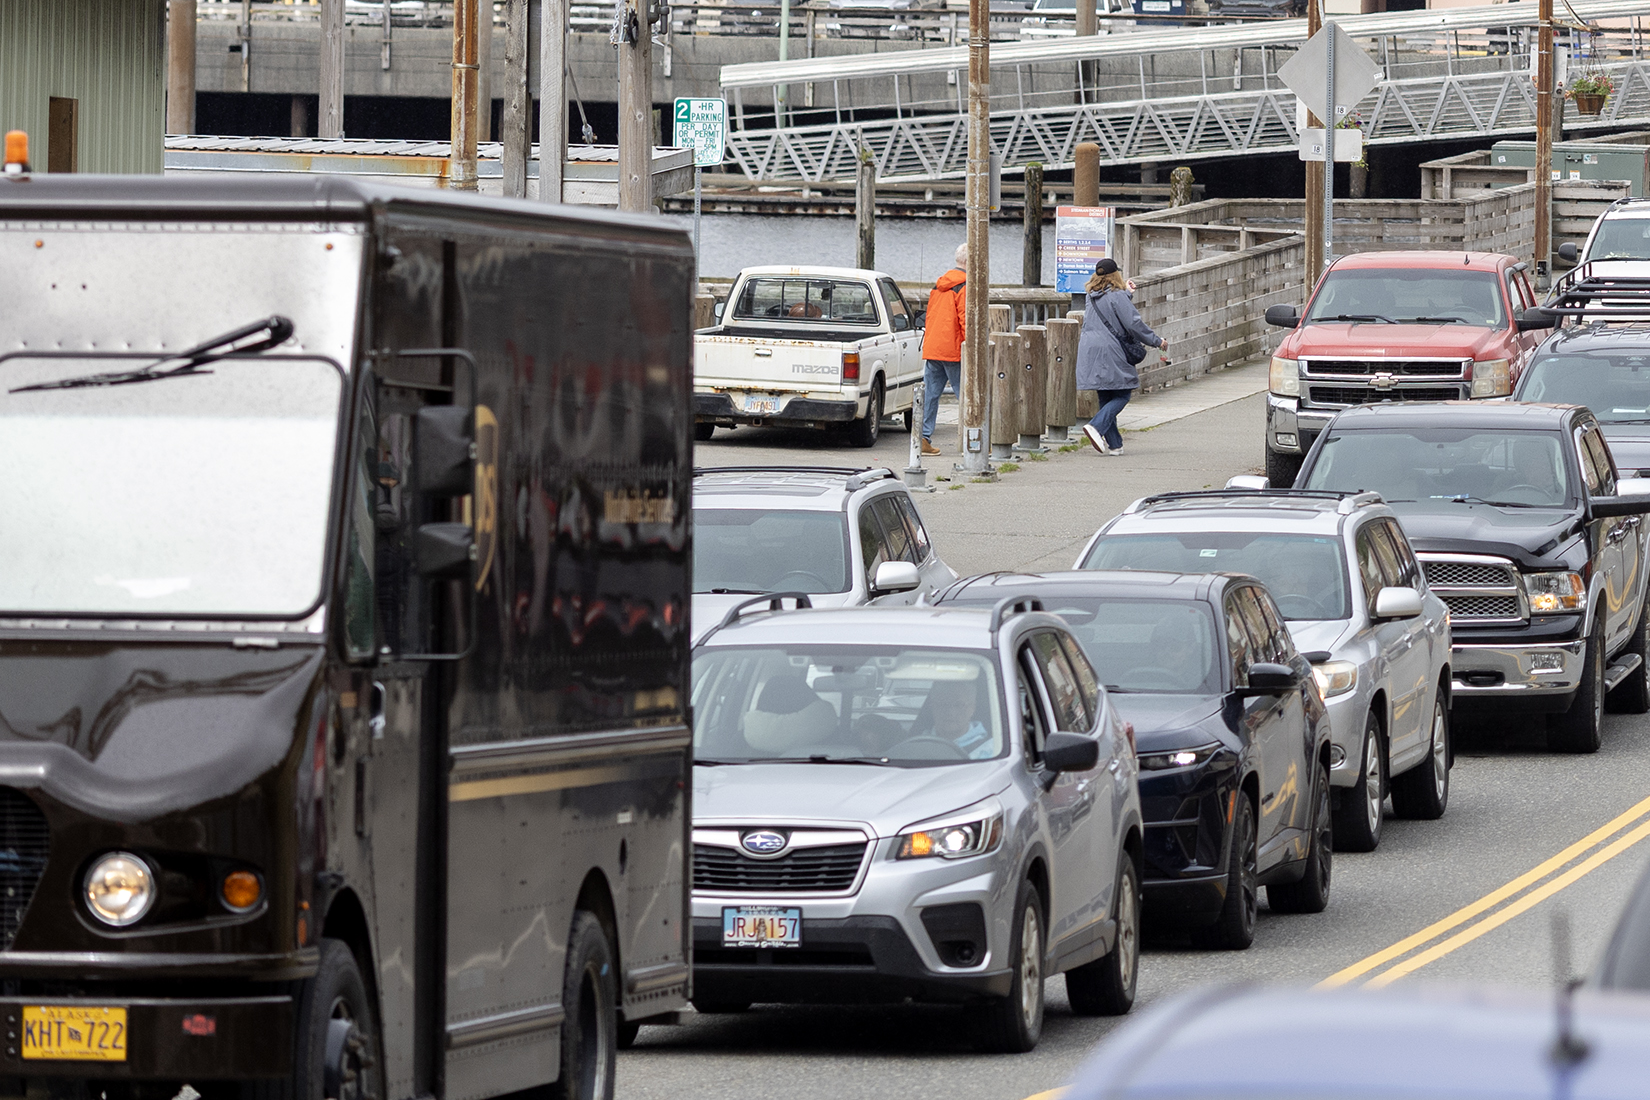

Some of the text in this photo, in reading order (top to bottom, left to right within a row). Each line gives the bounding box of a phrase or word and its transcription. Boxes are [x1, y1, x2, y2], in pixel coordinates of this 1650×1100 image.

[677, 102, 714, 119] 2 HR
[691, 112, 722, 122] PARKING
[681, 123, 718, 131] PER DAY
[694, 130, 720, 138] PERMIT
[769, 917, 798, 939] 157
[24, 1019, 124, 1049] KHT 722
